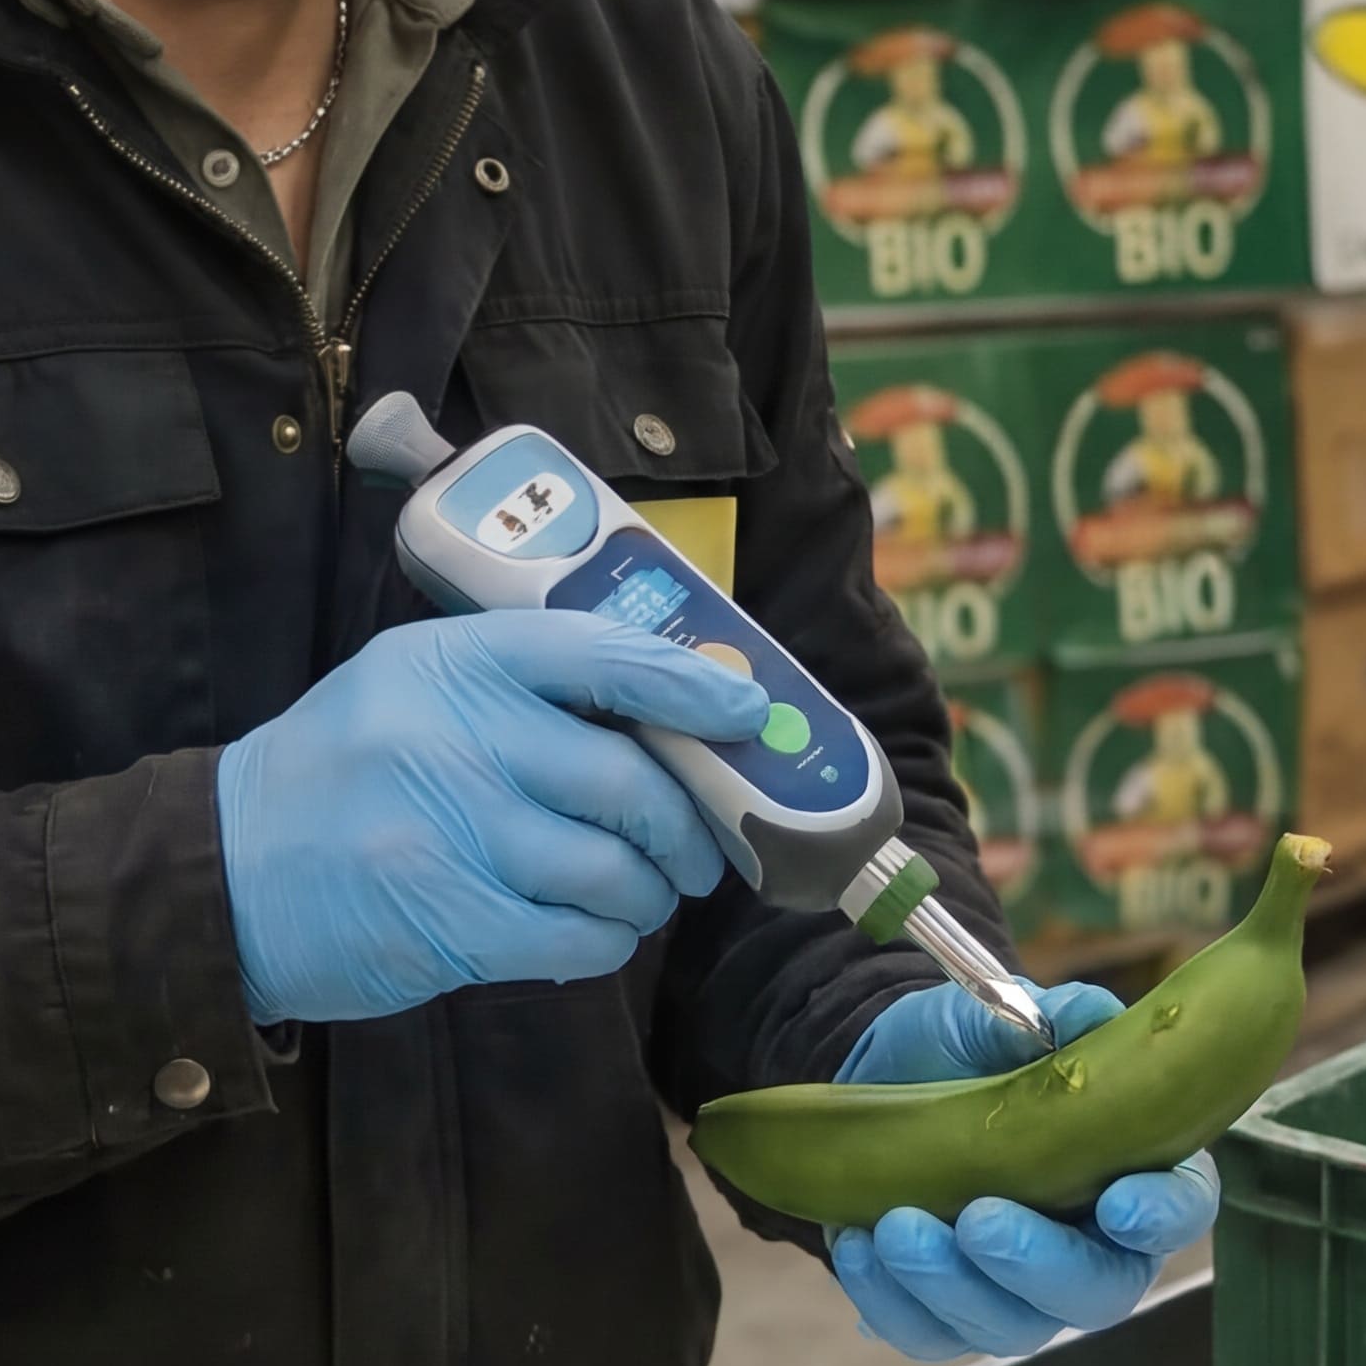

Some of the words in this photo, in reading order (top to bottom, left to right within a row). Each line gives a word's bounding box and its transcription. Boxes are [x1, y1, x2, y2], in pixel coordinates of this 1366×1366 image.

[866, 214, 987, 298] BIO
[1114, 200, 1233, 285] BIO
[1115, 549, 1234, 641] BIO
